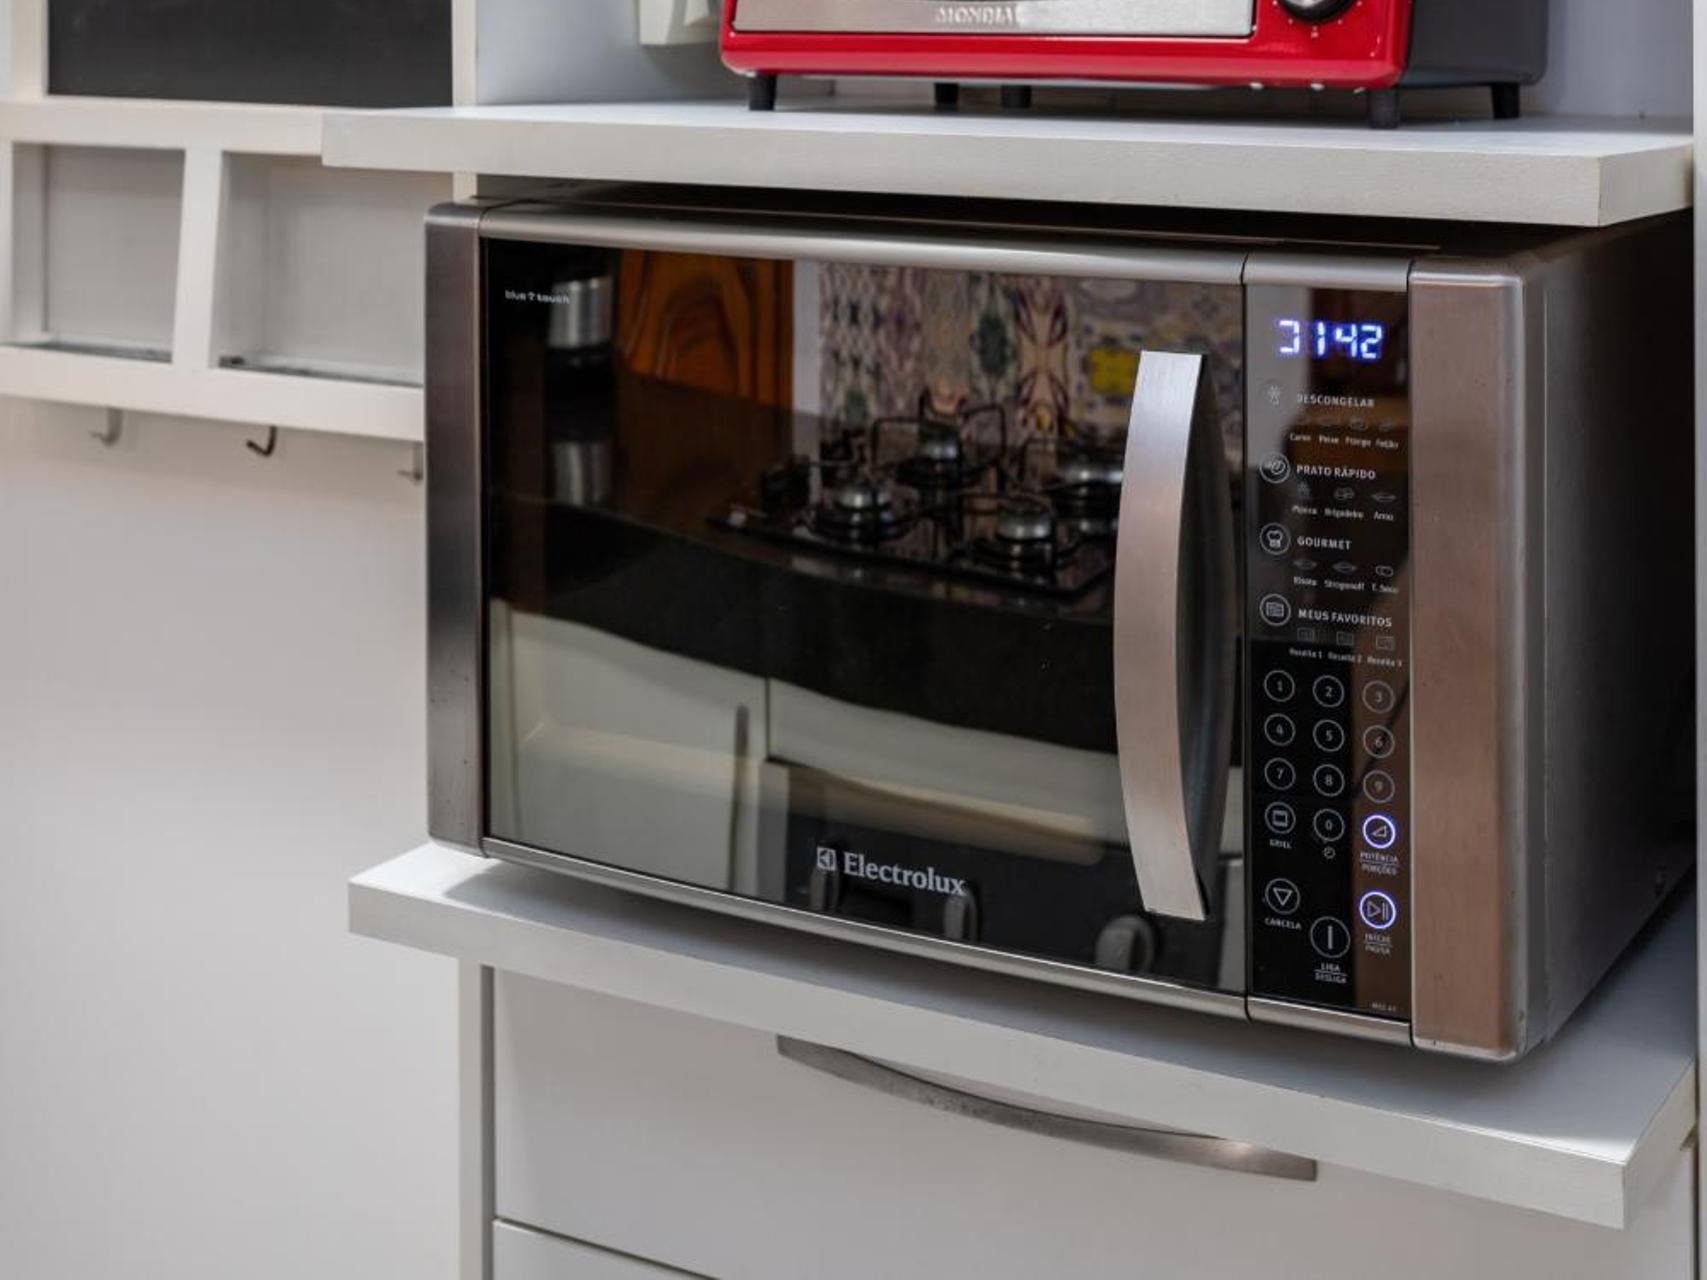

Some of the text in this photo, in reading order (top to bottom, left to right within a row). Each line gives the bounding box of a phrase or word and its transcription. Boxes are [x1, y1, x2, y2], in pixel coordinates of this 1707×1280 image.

[935, 5, 1020, 25] MONDIA
[1297, 394, 1375, 408] DESCONGELAR
[1296, 464, 1332, 477] PRATO
[1296, 536, 1352, 551] GOURMET
[1298, 608, 1393, 628] MEUS FAVORITOS
[843, 850, 967, 897] Electrolux
